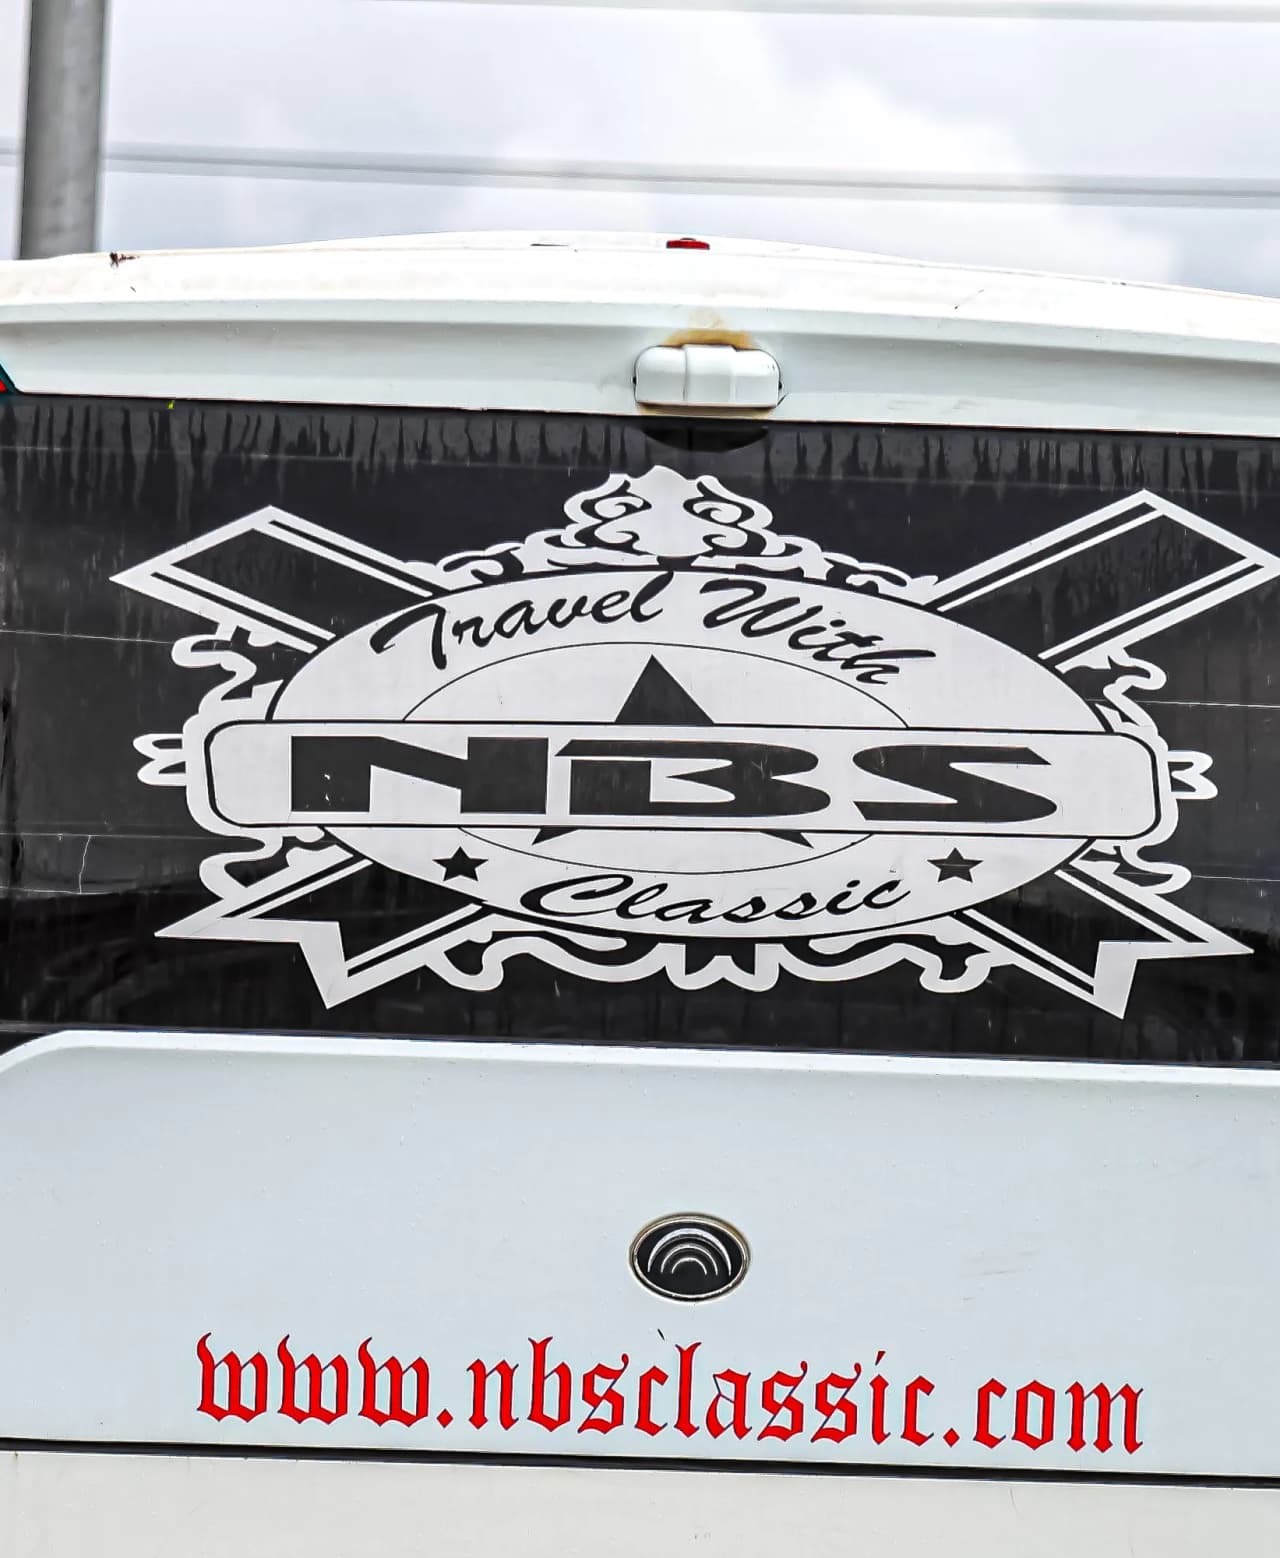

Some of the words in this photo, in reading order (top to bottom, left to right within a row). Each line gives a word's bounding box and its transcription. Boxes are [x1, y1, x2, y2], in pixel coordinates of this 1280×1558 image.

[369, 573, 665, 671] Travel
[699, 577, 937, 686] With
[290, 735, 1058, 823] NBS
[519, 872, 911, 925] Classic
[196, 1334, 1142, 1454] www.nbsclassic.com
